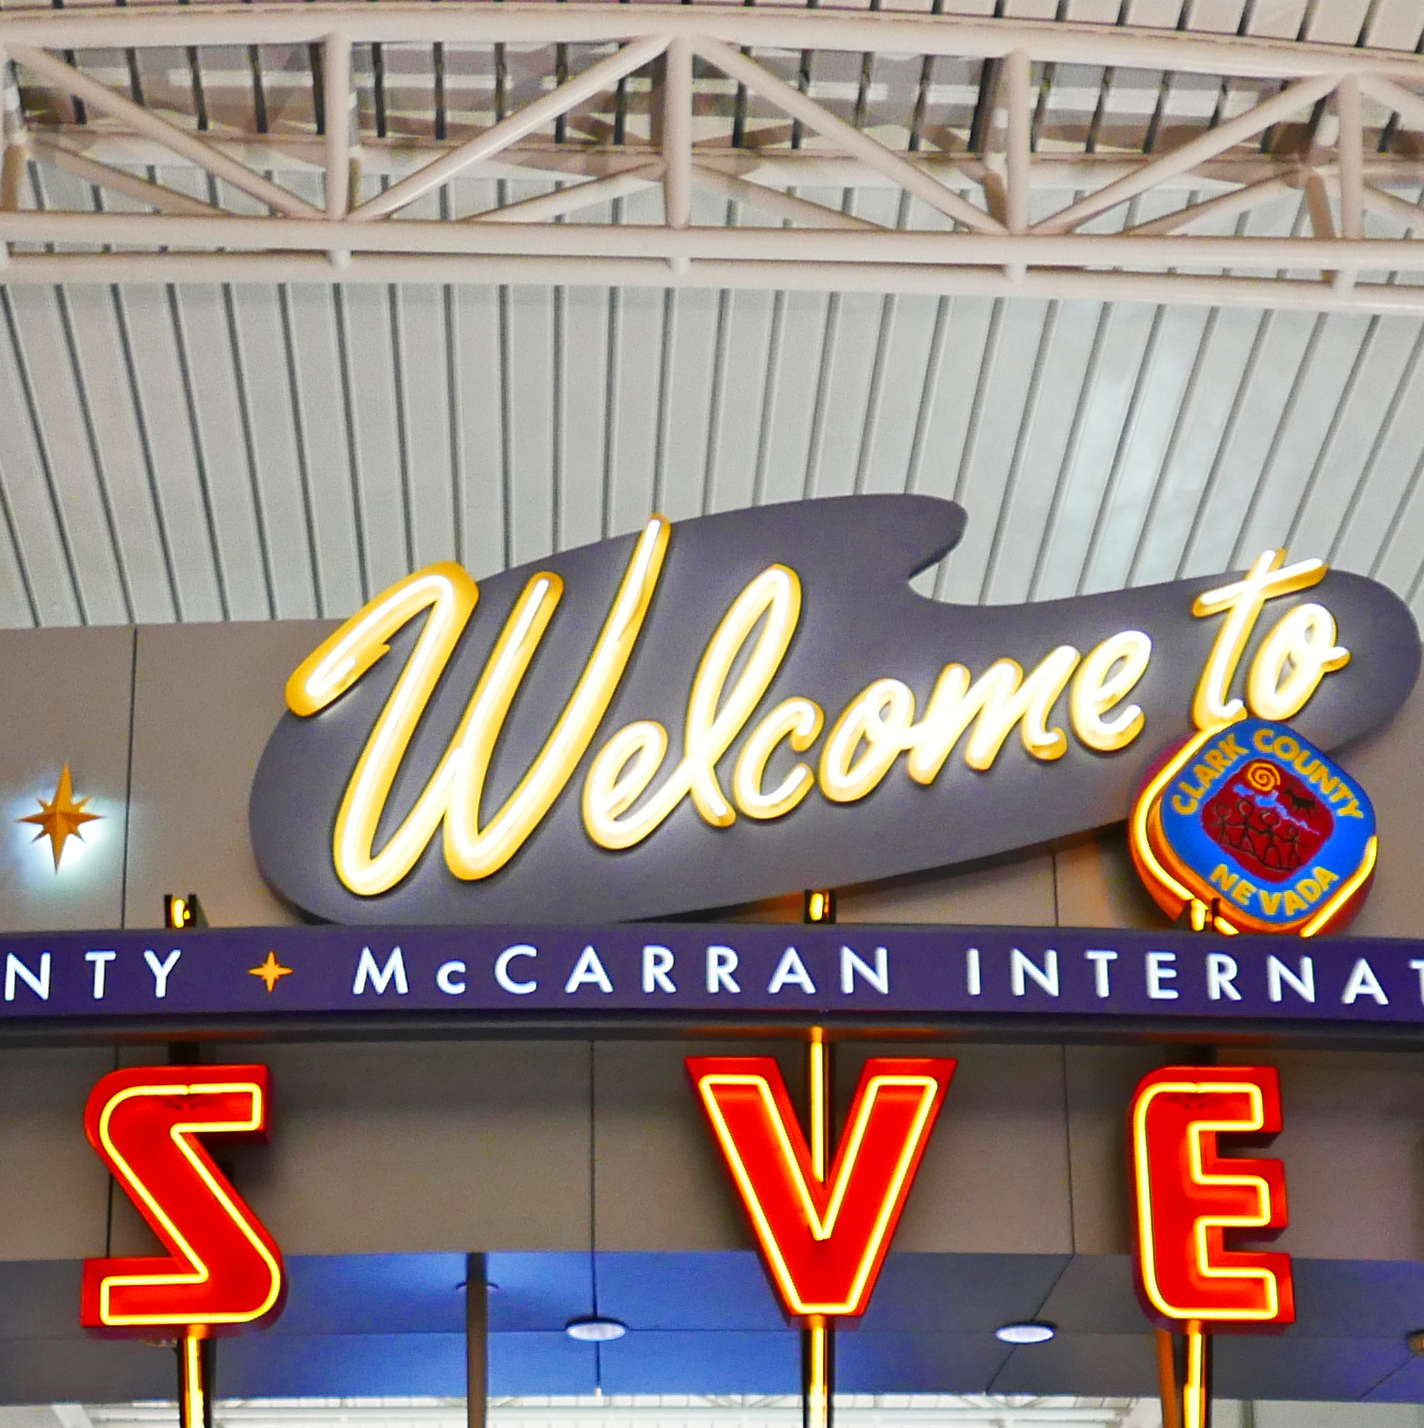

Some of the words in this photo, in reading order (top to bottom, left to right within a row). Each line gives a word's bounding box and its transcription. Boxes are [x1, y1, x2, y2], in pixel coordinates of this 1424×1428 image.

[284, 513, 1152, 897] Welcome
[1188, 546, 1352, 731] to
[1171, 733, 1250, 816] CLARK
[1252, 728, 1365, 820] COUNTY
[1209, 863, 1340, 917] NEVADA
[351, 944, 890, 996] McCARRAN
